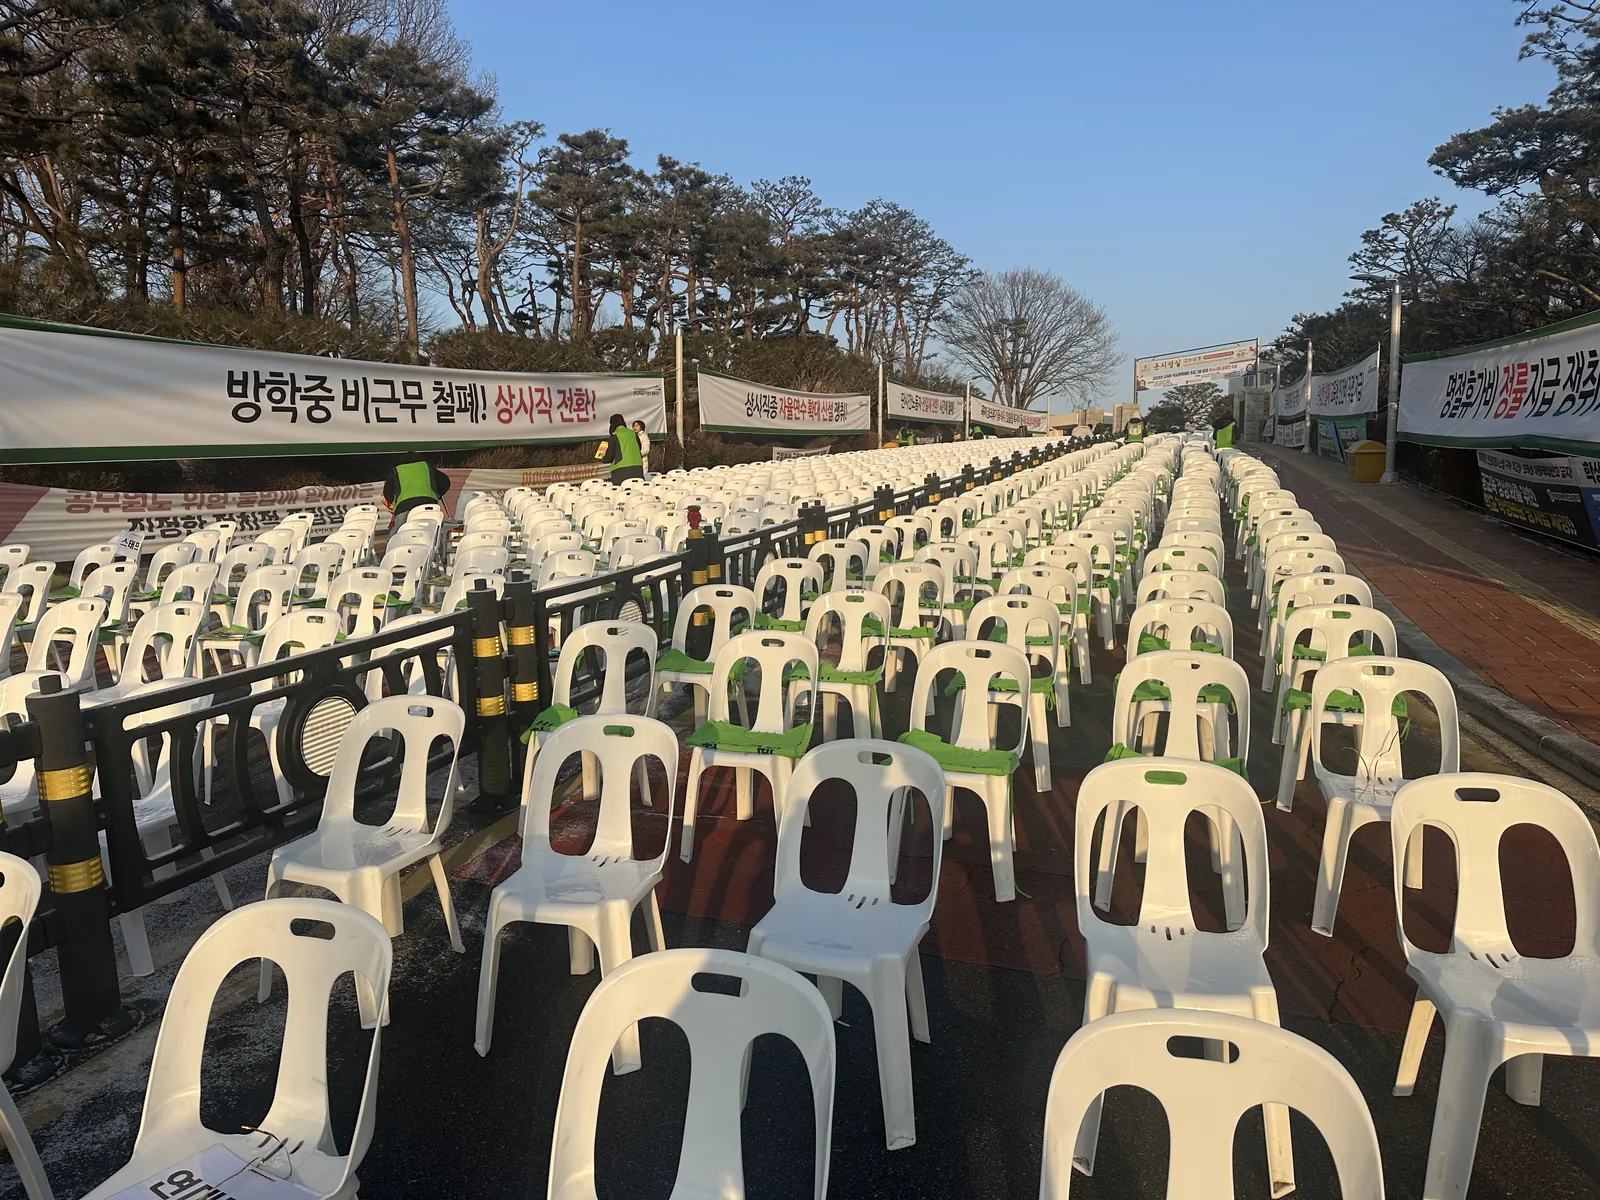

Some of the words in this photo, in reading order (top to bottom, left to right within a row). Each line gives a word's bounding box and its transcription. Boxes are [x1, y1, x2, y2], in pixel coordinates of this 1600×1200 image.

[227, 369, 336, 424] 방학중
[341, 376, 428, 424] 비근무
[432, 380, 488, 424] 철폐!
[494, 384, 553, 425] 상시직
[556, 385, 597, 424] 전환!
[744, 392, 778, 420] 상시직종
[779, 396, 807, 421] 자율연수
[821, 400, 834, 422] 신설
[1439, 365, 1500, 419] 명절휴가비
